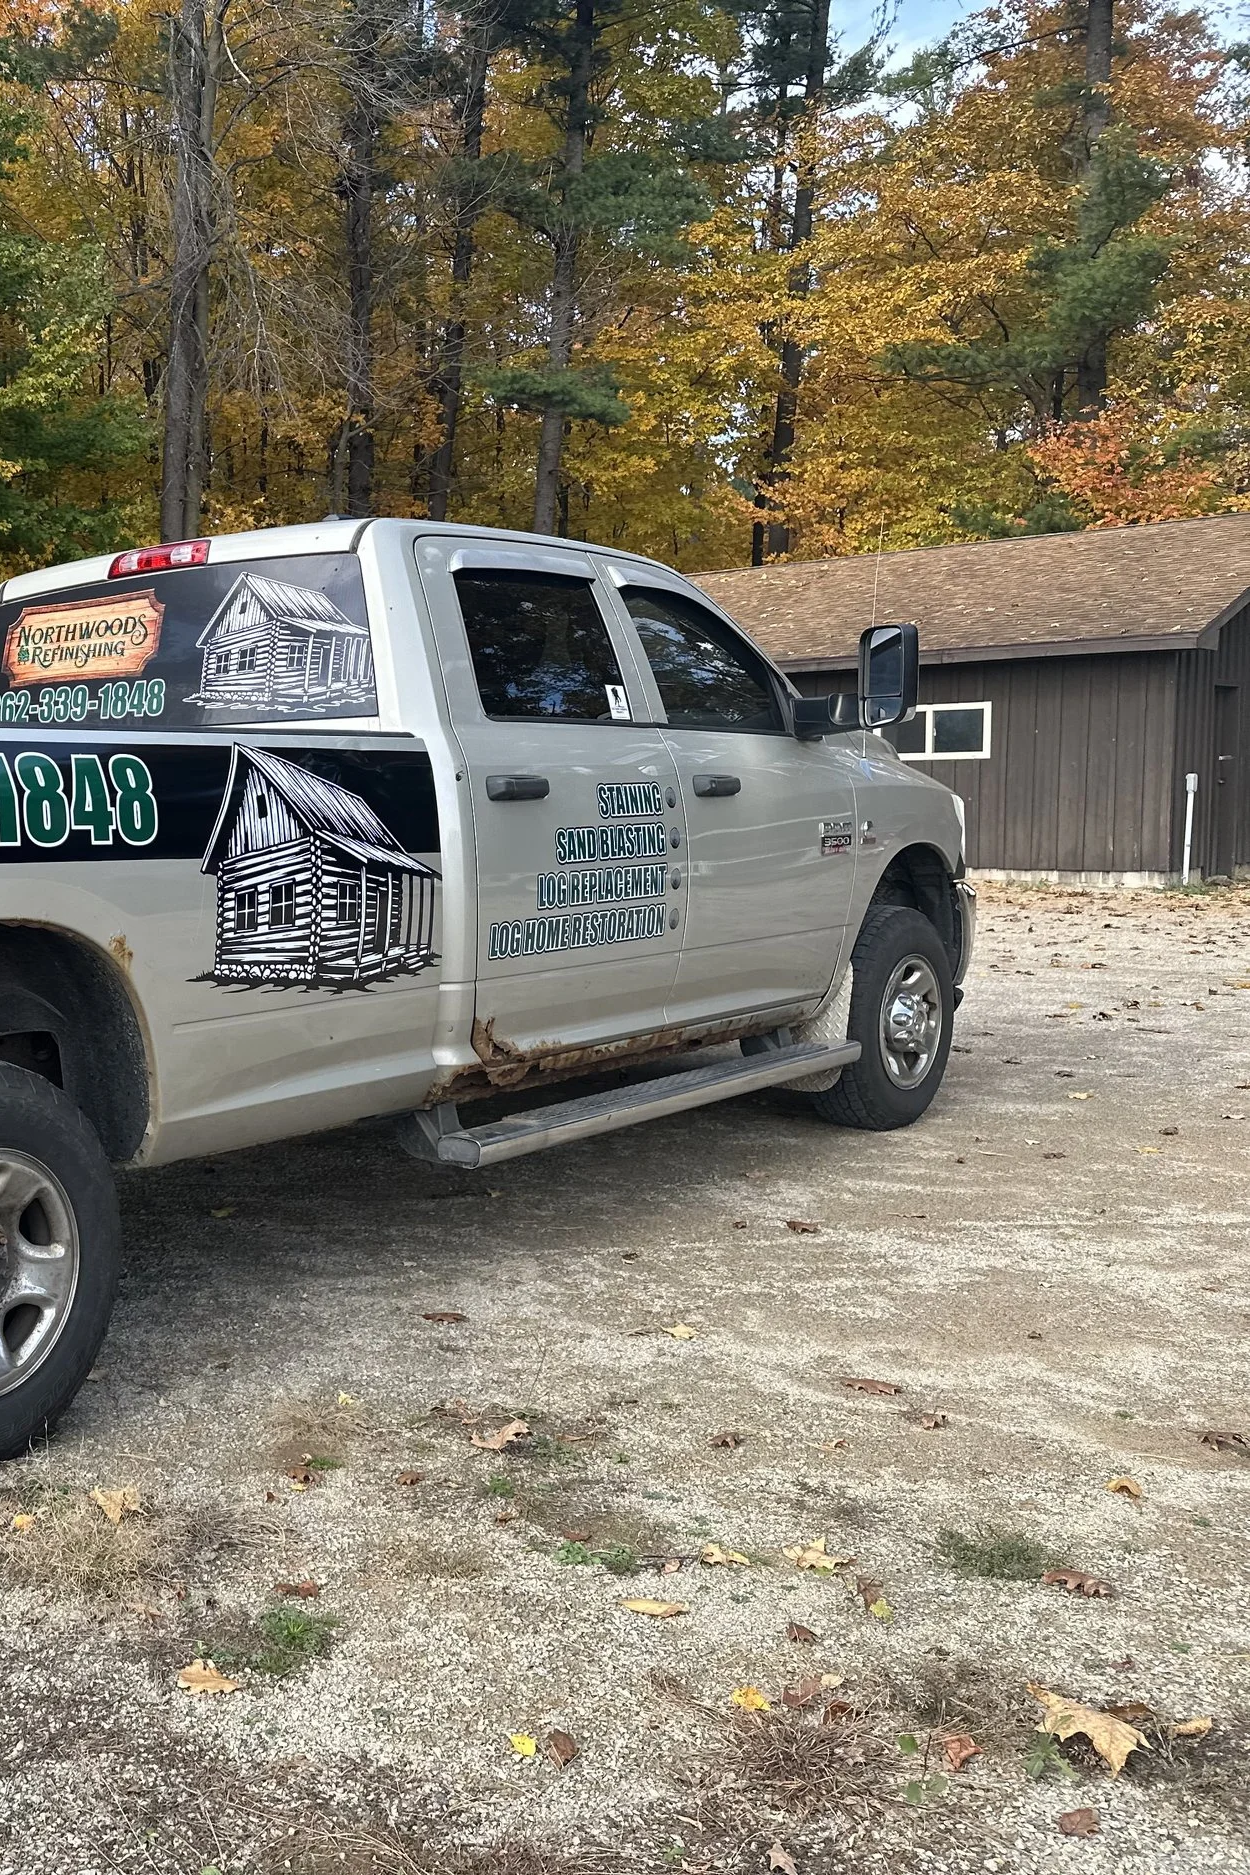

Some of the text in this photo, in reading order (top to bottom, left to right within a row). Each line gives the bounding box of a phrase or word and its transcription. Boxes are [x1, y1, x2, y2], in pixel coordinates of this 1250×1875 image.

[17, 614, 148, 648] NORTHWOODS
[31, 640, 126, 668] REFINISHING
[597, 782, 664, 818] STAINING
[555, 822, 667, 865] SAND BLASTING
[537, 863, 668, 910] LOG REPLACEMENT
[488, 903, 667, 960] LOG HOME RESTORATION
